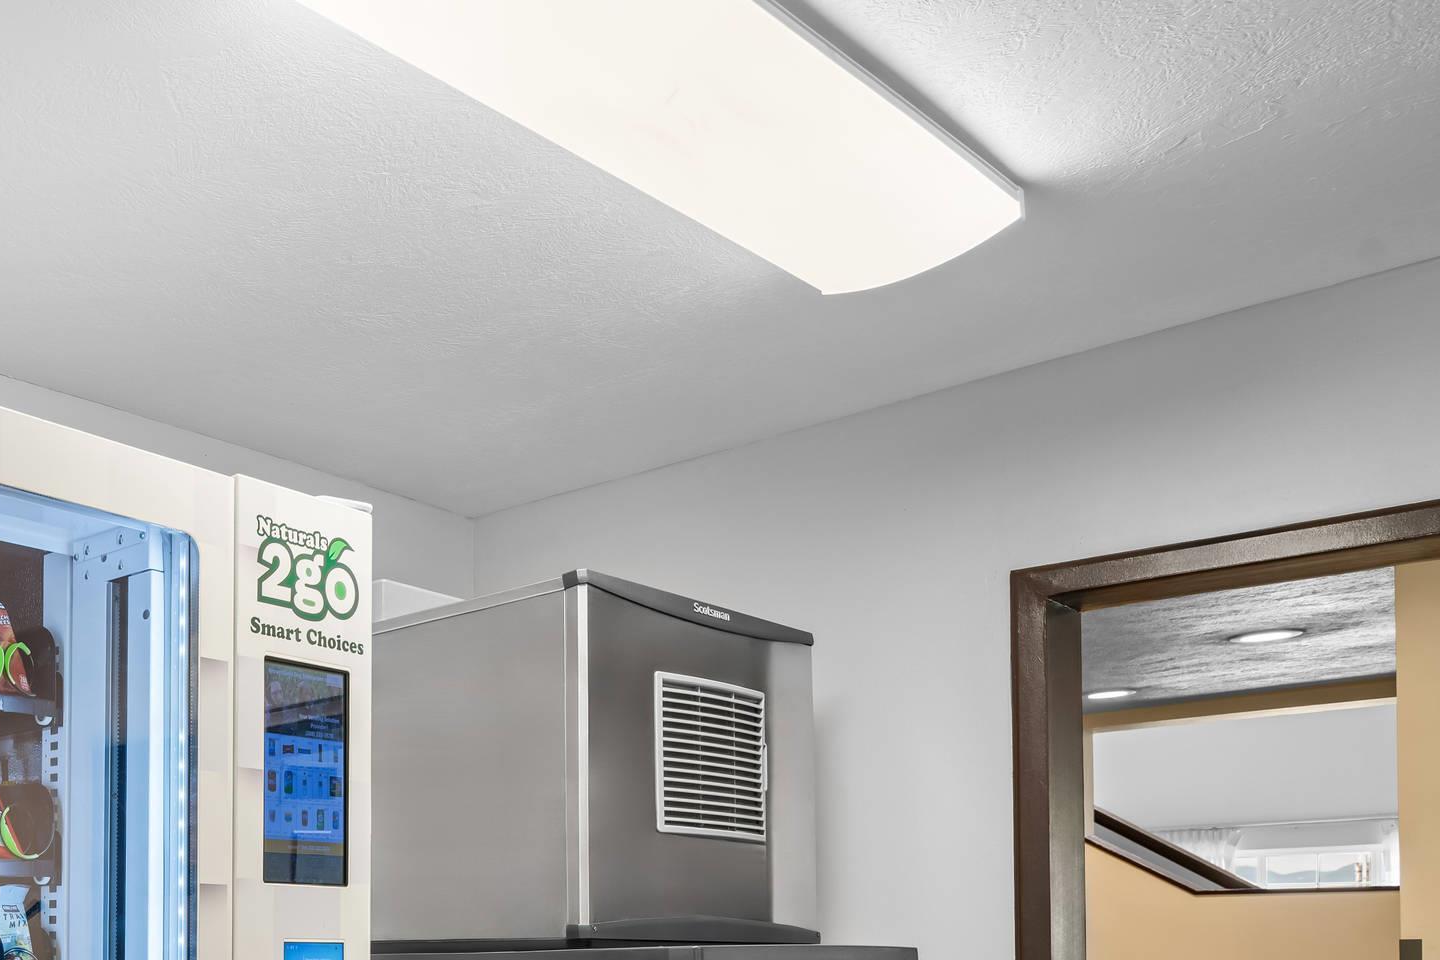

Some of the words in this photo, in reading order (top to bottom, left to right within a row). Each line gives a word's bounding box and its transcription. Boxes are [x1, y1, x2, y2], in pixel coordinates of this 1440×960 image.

[257, 514, 328, 550] Naturals
[693, 602, 730, 621] Scotsman
[250, 616, 302, 642] Smart
[306, 629, 364, 655] Choices
